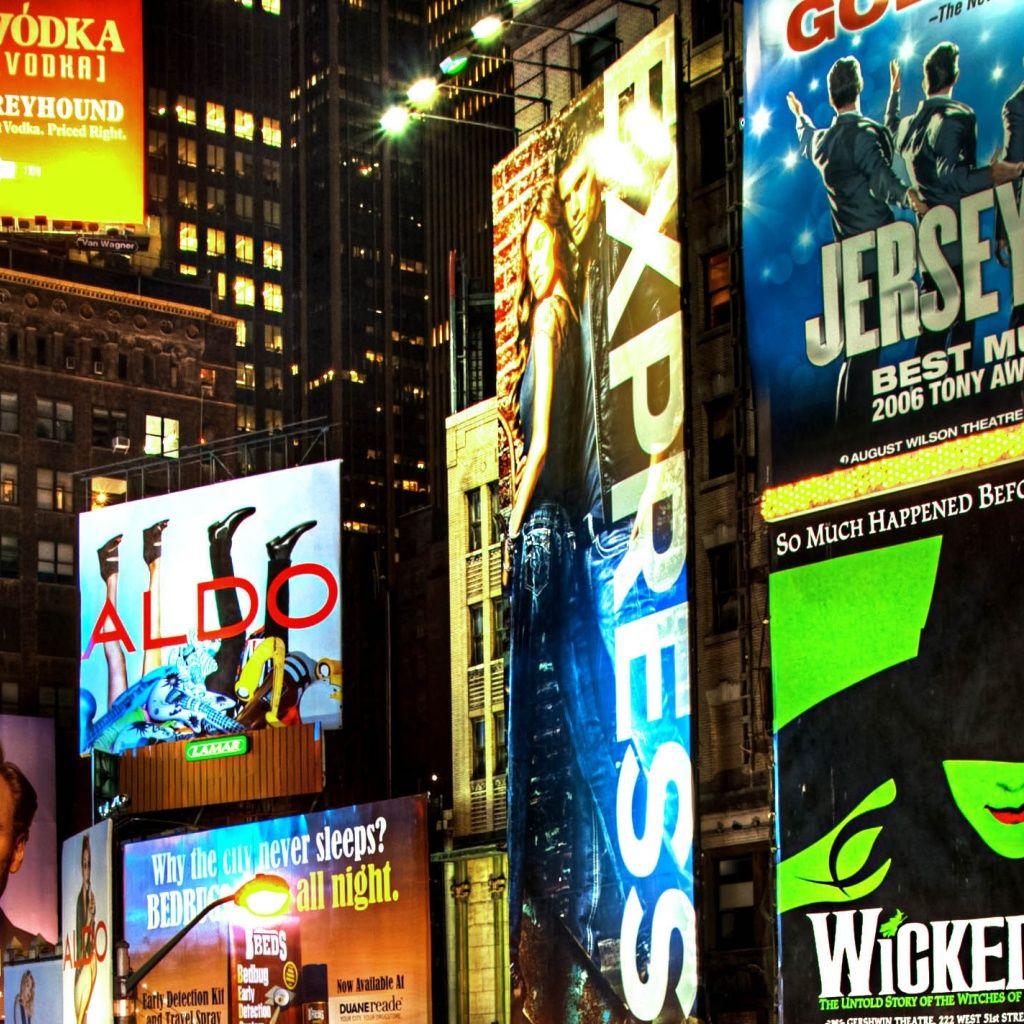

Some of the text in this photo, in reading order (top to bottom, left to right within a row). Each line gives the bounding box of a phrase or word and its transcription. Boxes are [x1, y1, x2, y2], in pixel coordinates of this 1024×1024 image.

[3, 121, 44, 136] Vodka.
[48, 122, 87, 138] Priced
[90, 125, 126, 141] Right.
[82, 238, 136, 250] Van Wagner
[805, 182, 1024, 367] JERSEY
[872, 342, 972, 395] BEST
[872, 387, 925, 422] 2006
[929, 368, 986, 406] TONY
[850, 409, 1024, 464] AUGUST WILSON THEATRE
[603, 15, 698, 1021] EXPRESS
[81, 562, 339, 660] ALDO
[190, 739, 243, 758] LAMAR
[152, 817, 387, 886] Why the city never sleeps?
[297, 861, 399, 912] all night.
[63, 920, 108, 971] ALDO
[237, 964, 269, 986] Bedbug
[337, 979, 353, 994] Now
[356, 976, 393, 992] Available
[142, 987, 224, 1010] Early Detection Kit
[238, 986, 255, 1003] Early
[238, 1003, 272, 1019] Detection
[956, 1014, 981, 1024] WEST
